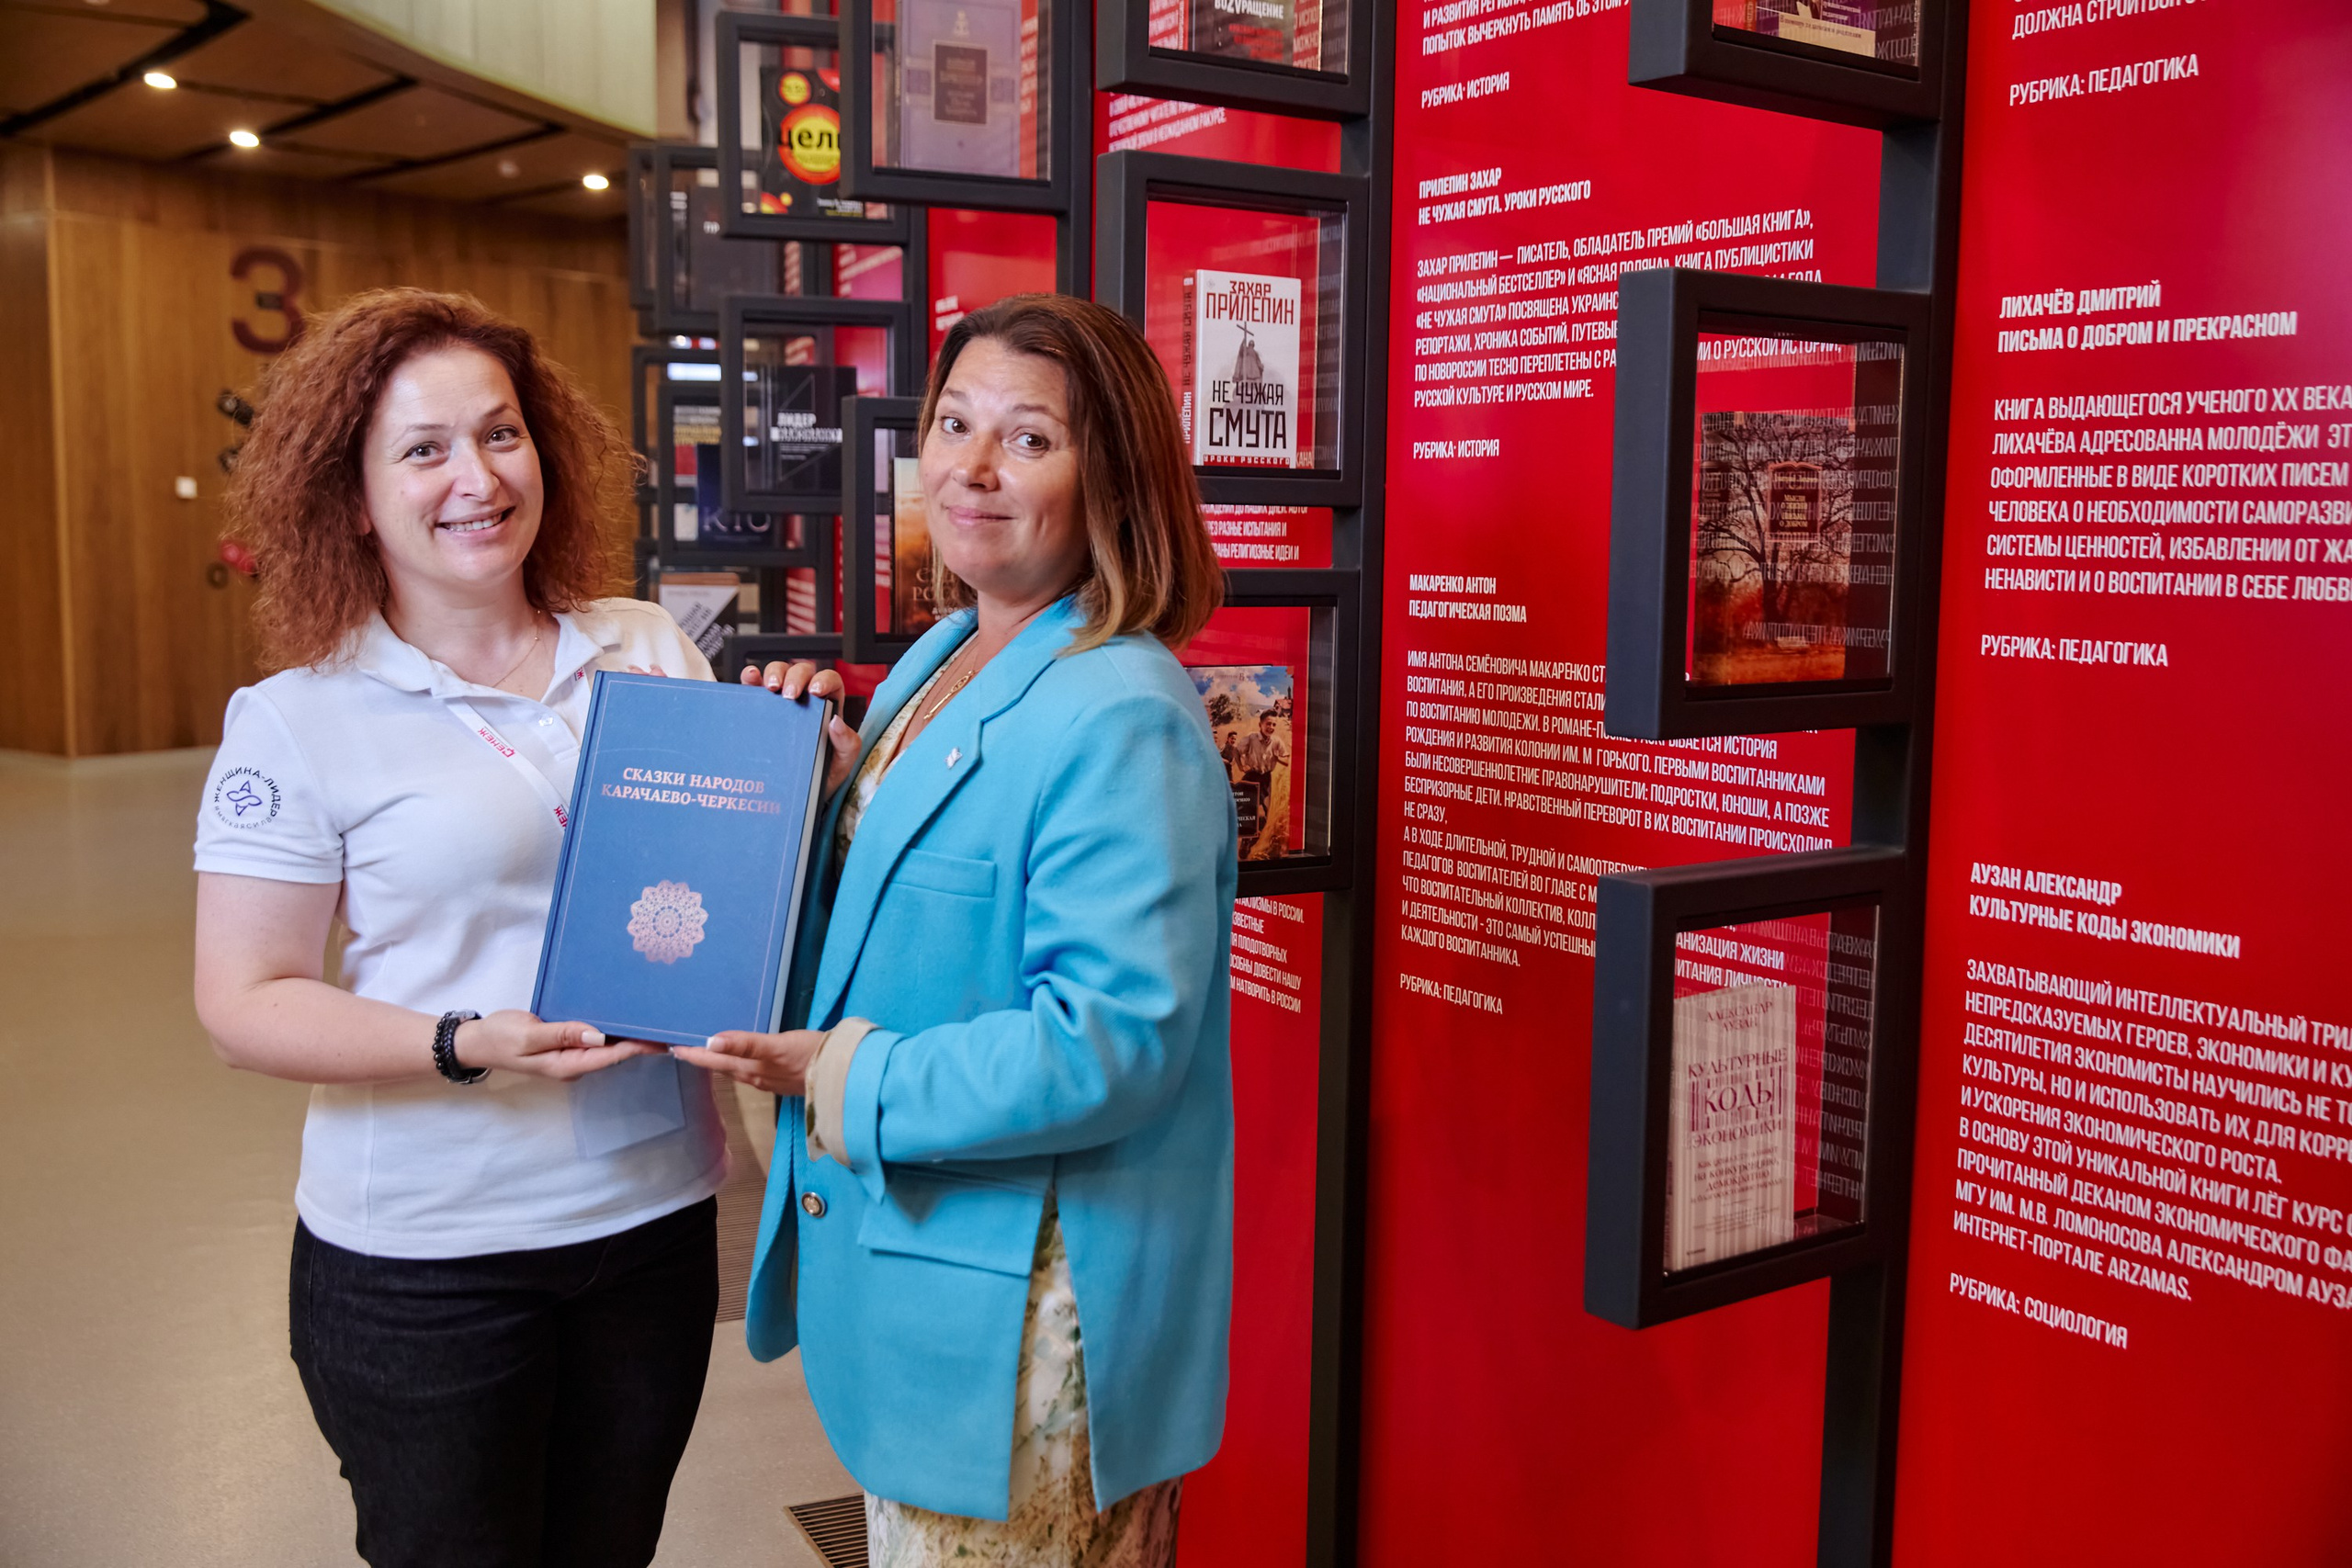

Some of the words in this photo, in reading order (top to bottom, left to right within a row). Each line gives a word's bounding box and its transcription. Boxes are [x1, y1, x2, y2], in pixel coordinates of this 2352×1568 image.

[1422, 27, 1465, 56] ПОПЫТОК
[1466, 11, 1531, 45] ВЫЧЕРКНУТЬ
[1532, 0, 1574, 28] ПАМЯТЬ
[2011, 2, 2083, 39] ДОЛЖНА
[1466, 71, 1510, 99] ИСТОРИЯ
[2009, 73, 2085, 106] РУБРИКА:
[2087, 53, 2199, 93] ПЕДАГОГИКА
[1419, 173, 1468, 199] ПРИЛЕПИН
[1469, 166, 1501, 190] ЗАХАР
[1431, 199, 1465, 222] ЧУЖАЯ
[1466, 194, 1502, 218] СМУТА.
[1503, 187, 1536, 211] УРОКИ
[1538, 179, 1590, 206] РУССКОГО
[1417, 256, 1448, 277] ЗАХАР
[1448, 249, 1498, 274] ПРИЛЕПИН
[1516, 240, 1570, 265] ПИСАТЕЛЬ,
[1573, 230, 1645, 257] ОБЛАДАТЕЛЬ
[1646, 220, 1693, 248] ПРЕМИЙ
[1694, 213, 1760, 241] «БОЛЬШАЯ
[1761, 208, 1813, 233] КНИГА»,
[1416, 273, 1497, 303] «НАЦИОНАЛЬНЫЙ
[1498, 268, 1566, 294] БЕСТСЕЛЛЕР»
[1577, 262, 1617, 284] «ЯСНАЯ
[1714, 238, 1813, 269] ПУБЛИЦИСТИКИ
[1229, 280, 1272, 297] ЗАХАР
[1998, 288, 2074, 318] ЛИХАЧЁВ
[2075, 278, 2161, 315] ДМИТРИЙ
[1183, 291, 1193, 327] СМУТА
[1205, 292, 1295, 325] ПРИЛЕПИН
[1415, 333, 1472, 355] РЕПОРТАЖИ,
[1473, 328, 1518, 350] ХРОНИКА
[1520, 321, 1569, 346] СОБЫТИЙ,
[1997, 326, 2064, 353] ПИСЬМА
[2080, 321, 2153, 350] ДОБРОМ
[2172, 310, 2297, 342] ПРЕКРАСНОМ
[1183, 331, 1192, 368] ЧУЖАЯ
[1212, 379, 1231, 403] НЕ
[1235, 381, 1283, 406] ЧУЖАЯ
[1414, 384, 1454, 407] РУССКОЙ
[1455, 384, 1504, 405] КУЛЬТУРЕ
[1514, 380, 1561, 401] РУССКОМ
[1563, 378, 1593, 399] МИРЕ.
[1994, 397, 2044, 421] КНИГА
[2047, 391, 2182, 421] ВЫДАЮЩЕГОСЯ
[2185, 388, 2267, 414] УЧЕНОГО
[1209, 408, 1286, 449] СМУТА
[1204, 455, 1236, 463] УРОКИ
[1240, 456, 1291, 466] РУССКОГО
[1457, 438, 1499, 457] ИСТОРИЯ
[1990, 465, 2113, 488] ОФОРМЛЕННЫЕ
[2131, 464, 2178, 490] ВИДЕ
[2181, 462, 2278, 487] КОРОТКИХ
[2280, 461, 2349, 487] ПИСЕМ
[1243, 521, 1282, 536] ИСПЫТАНИЯ
[1988, 500, 2069, 522] ЧЕЛОВЕКА
[2086, 500, 2239, 525] НЕОБХОДИМОСТИ
[1231, 543, 1274, 560] РЕЛИГИОЗНЫЕ
[1986, 534, 2062, 557] СИСТЕМЫ
[2064, 532, 2165, 560] ЦЕННОСТЕЙ,
[2168, 536, 2290, 561] ИЗБАВЛЕНИИ
[1408, 573, 1464, 592] МАКАРЕНКО
[1464, 576, 1496, 593] АНТОН
[1984, 567, 2075, 592] НЕНАВИСТИ
[2108, 570, 2222, 596] ВОСПИТАНИИ
[2241, 574, 2289, 599] СЕБЕ
[1408, 599, 1491, 620] ПЕДАГОГИЧЕСКАЯ
[1492, 604, 1526, 623] ПОЭМА
[1407, 649, 1427, 668] ИМЯ
[1428, 651, 1464, 671] АНТОНА
[1465, 653, 1527, 676] СЕМЁНОВИЧА
[1529, 660, 1590, 682] МАКАРЕНКО
[1980, 634, 2055, 660] РУБРИКА:
[2058, 637, 2168, 667] ПЕДАГОГИКА
[1419, 701, 1480, 725] ВОСПИТАНИЮ
[1482, 708, 1540, 731] МОЛОДЕЖИ.
[214, 766, 281, 817] ЖЕНЩИНА-ЛИДЕР
[623, 767, 685, 787] СКАЗКИ
[689, 773, 764, 795] НАРОДОВ
[1405, 750, 1430, 769] БЫЛИ
[1431, 754, 1540, 784] НЕСОВЕРШЕННОЛЕТНИЕ
[1542, 769, 1648, 800] ПРАВОНАРУШИТЕЛИ:
[1649, 783, 1719, 813] ПОДРОСТКИ,
[1721, 793, 1770, 820] ЮНОШИ,
[1784, 802, 1829, 828] ПОЗЖЕ
[600, 784, 781, 815] КАРАЧАЕВО-ЧЕРКЕСИИ
[1416, 802, 1447, 824] СРАЗУ,
[1419, 828, 1443, 849] ХОДЕ
[1444, 832, 1508, 861] ДЛИТЕЛЬНОЙ,
[1510, 843, 1555, 868] ТРУДНОЙ
[1402, 874, 1419, 893] ЧТО
[1420, 878, 1503, 910] ВОСПИТАТЕЛЬНЫЙ
[1505, 895, 1565, 925] КОЛЛЕКТИВ,
[1970, 862, 2021, 889] АУЗАН
[2023, 869, 2121, 906] АЛЕКСАНДР
[1969, 894, 2074, 931] КУЛЬТУРНЫЕ
[2076, 910, 2127, 941] КОДЫ
[2130, 919, 2240, 958] ЭКОНОМИКИ
[1238, 934, 1288, 964] ПЛОДОТВОРНЫХ
[1400, 923, 1444, 949] КАЖДОГО
[1445, 933, 1521, 966] ВОСПИТАННИКА.
[1739, 942, 1784, 970] ЖИЗНИ
[1253, 962, 1282, 985] ДОВЕСТИ
[1282, 971, 1302, 990] НАШУ
[1399, 972, 1442, 998] РУБРИКА:
[1442, 983, 1502, 1014] ПЕДАГОГИКА
[1236, 976, 1271, 1002] НАТВОРИТЬ
[1276, 992, 1301, 1013] РОССИИ
[1966, 958, 2112, 1006] ЗАХВАТЫВАЮЩИЙ
[2115, 986, 2307, 1043] ИНТЕЛЛЕКТУАЛЬНЫЙ
[1688, 1048, 1788, 1078] КУЛЬТУРНЫЕ
[1962, 1021, 2072, 1066] ДЕСЯТИЛЕТИЯ
[2074, 1045, 2188, 1091] ЭКОНОМИСТЫ
[2191, 1070, 2301, 1114] НАУЧИЛИСЬ
[1705, 1076, 1775, 1115] КОДЫ
[1691, 1120, 1782, 1148] ЭКОНОМИКИ
[1972, 1087, 2061, 1129] УСКОРЕНИЯ
[2063, 1110, 2216, 1168] ЭКОНОМИЧЕСКОГО
[2220, 1146, 2281, 1183] РОСТА.
[1972, 1119, 2030, 1153] ОСНОВУ
[2031, 1134, 2073, 1166] ЭТОЙ
[2075, 1145, 2187, 1195] УНИКАЛЬНОЙ
[2189, 1174, 2249, 1211] КНИГИ
[2253, 1190, 2289, 1218] ЛЁГ
[2291, 1200, 2343, 1233] КУРС
[1955, 1178, 1986, 1205] МГУ
[2052, 1207, 2163, 1258] ЛОМОНОСОВА
[2165, 1238, 2303, 1297] АЛЕКСАНДРОМ
[1952, 1210, 2104, 1275] ИНТЕРНЕТ-ПОРТАЛЕ
[2107, 1256, 2191, 1301] ARZAMAS.
[1949, 1271, 2019, 1314] РУБРИКА:
[2023, 1296, 2127, 1348] СОЦИОЛОГИЯ
